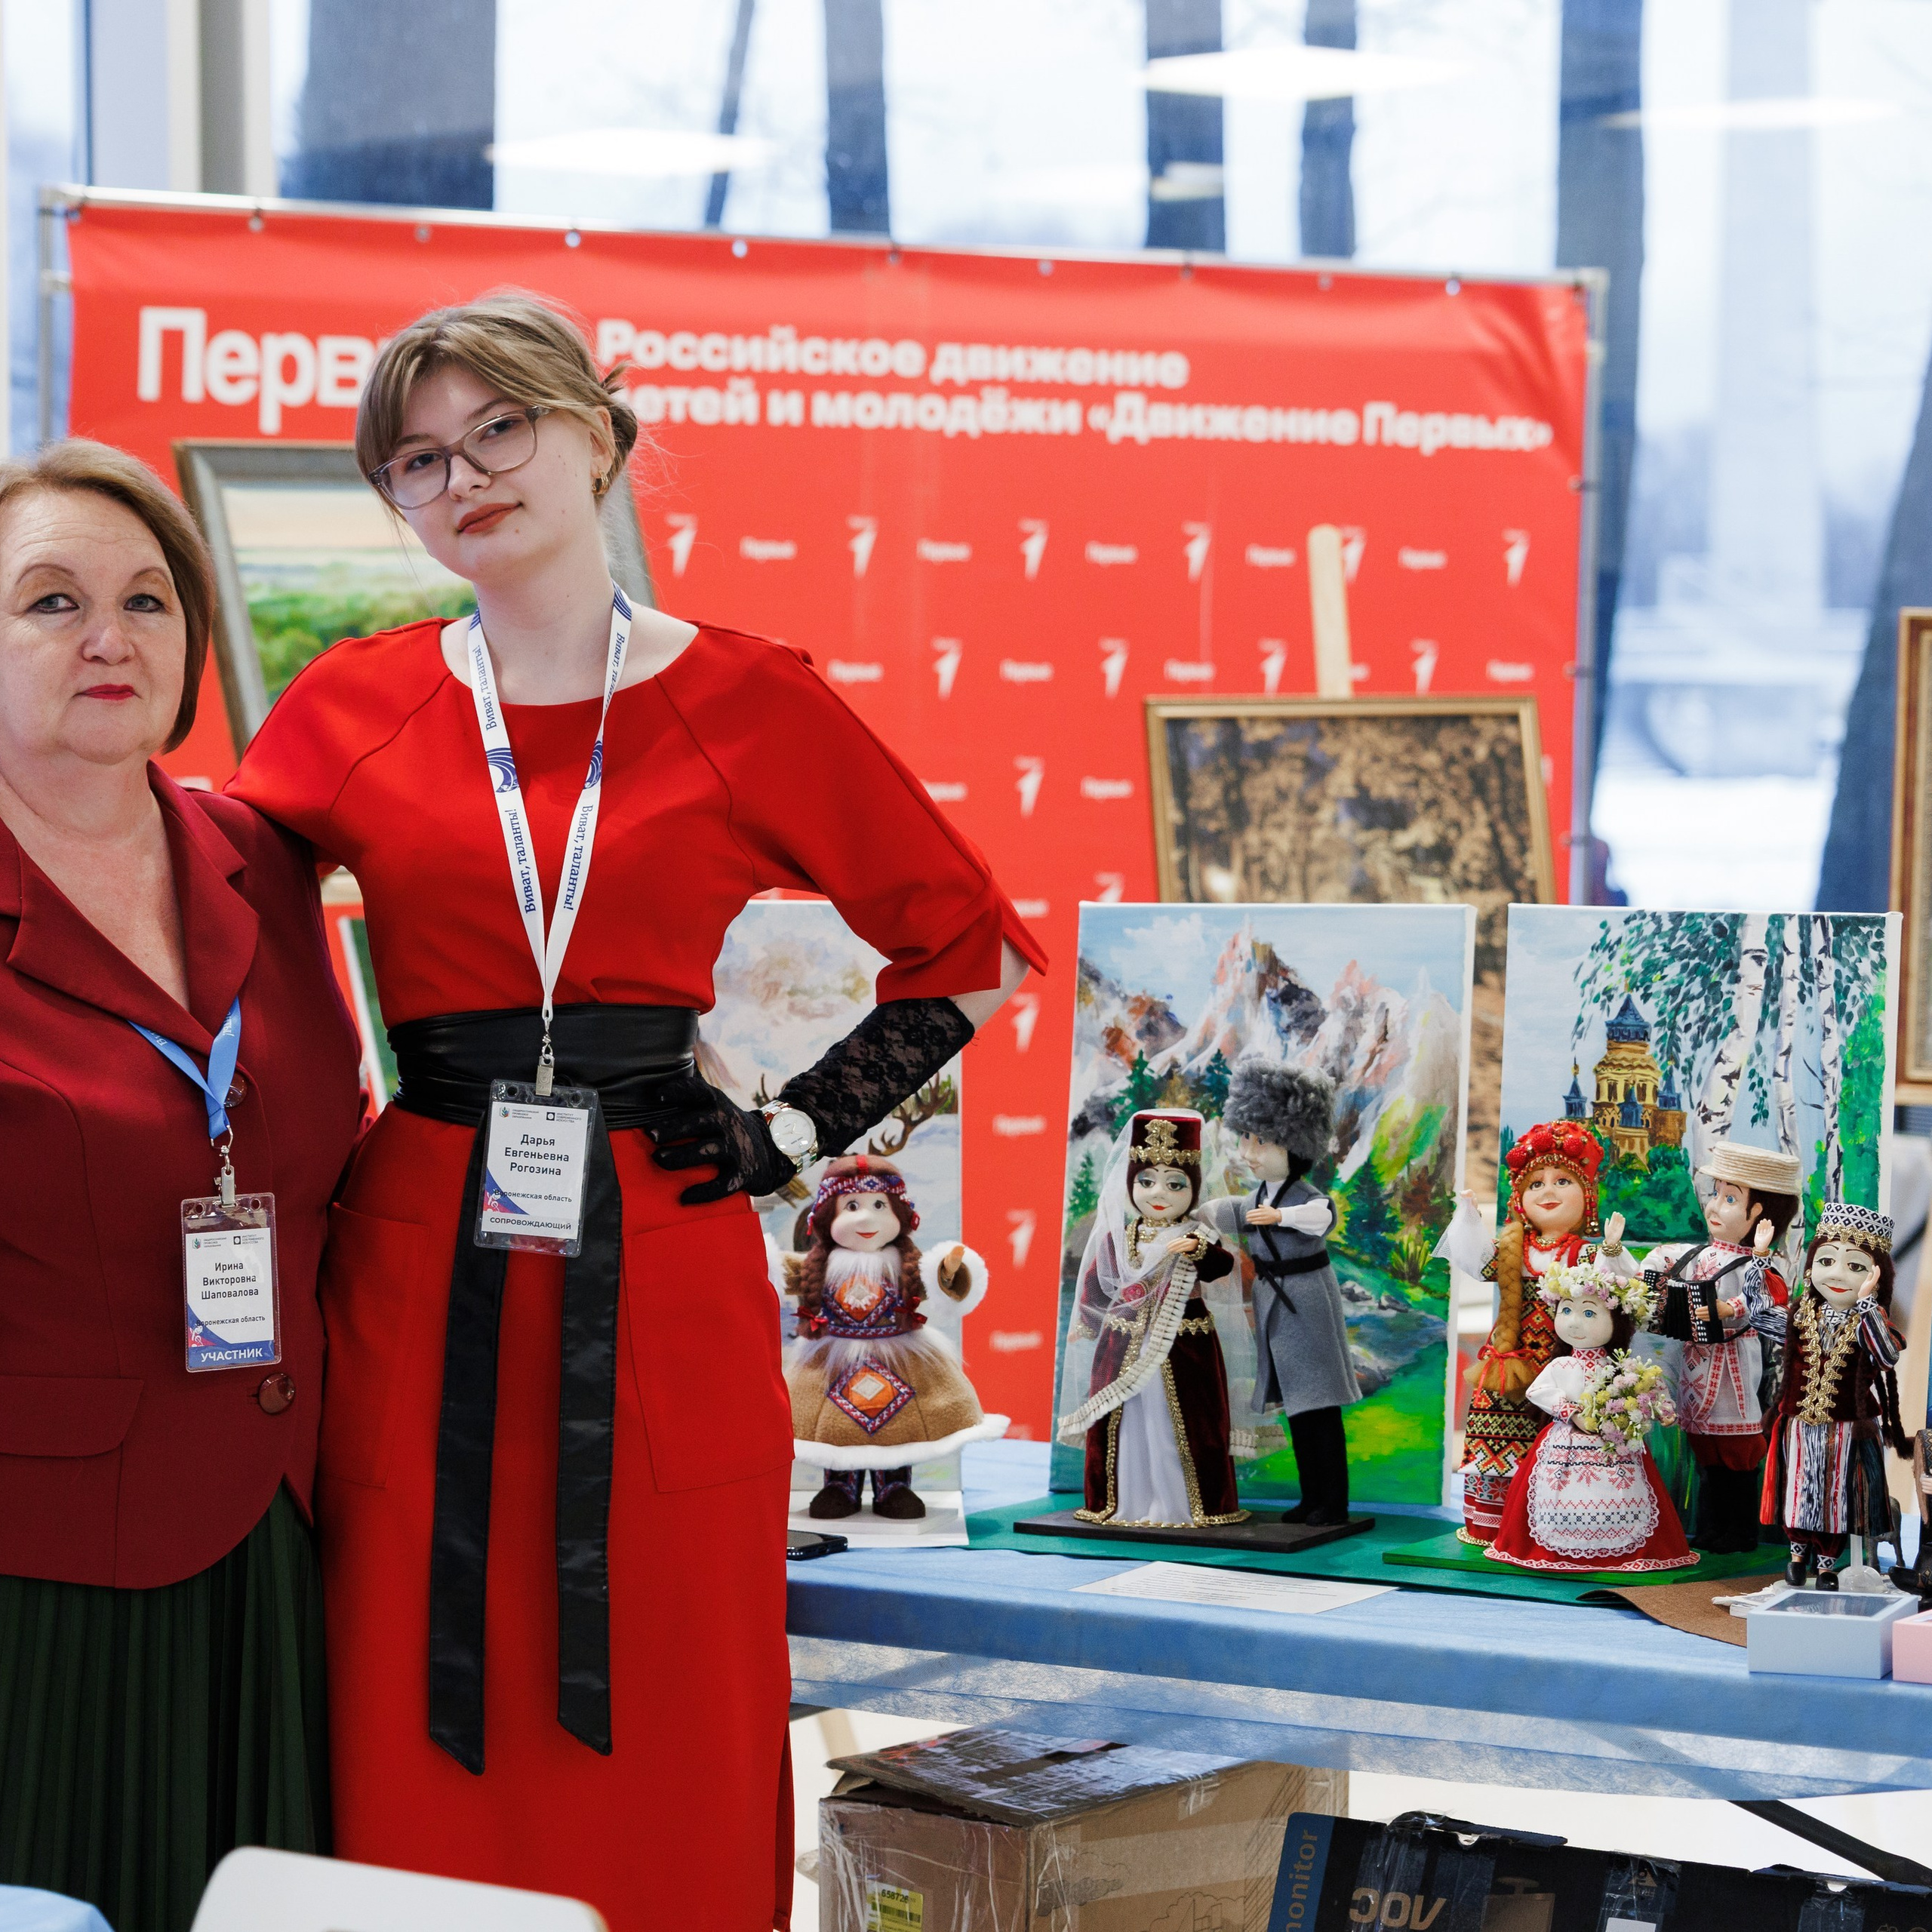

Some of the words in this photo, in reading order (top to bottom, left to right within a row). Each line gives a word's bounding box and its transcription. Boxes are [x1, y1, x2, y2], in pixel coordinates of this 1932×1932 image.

[597, 318, 926, 377] Российское
[928, 340, 1189, 389] движение
[767, 388, 804, 428] и
[811, 385, 1081, 440] молодёжи
[1088, 391, 1360, 445] «Движение
[612, 632, 626, 667] Виват,
[472, 645, 489, 693] таланты!
[482, 693, 497, 731] Виват,
[575, 804, 593, 843] Виват,
[504, 808, 527, 865] таланты!
[563, 845, 583, 911] таланты!
[521, 866, 537, 914] Виват,
[521, 1134, 555, 1146] Дарья
[504, 1147, 570, 1162] Евгеньевна
[510, 1162, 561, 1176] Рогозина
[494, 1189, 543, 1200] Воронежская
[543, 1193, 572, 1203] область
[490, 1217, 571, 1230] СОПРОВОЖДАЮЩИЙ
[214, 1262, 244, 1273] Ирина
[202, 1275, 257, 1286] Викторовна
[201, 1288, 259, 1300] Шаповалова
[196, 1317, 239, 1327] Воронежская
[241, 1315, 266, 1324] область
[201, 1347, 263, 1362] УЧАСТНИК
